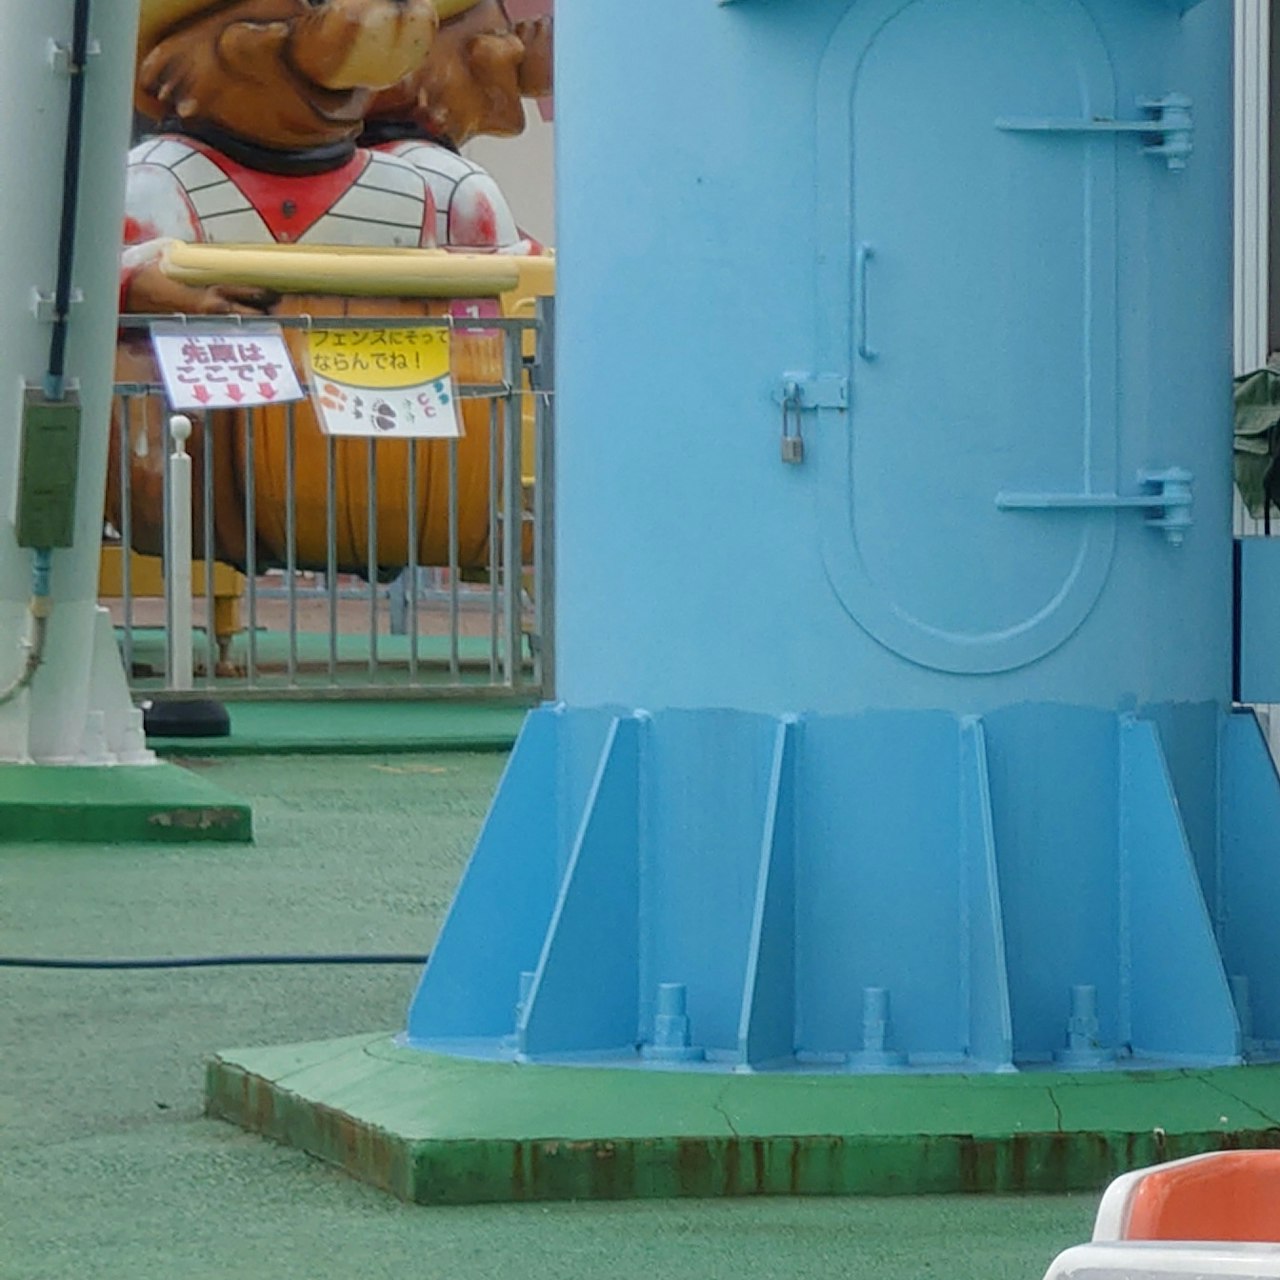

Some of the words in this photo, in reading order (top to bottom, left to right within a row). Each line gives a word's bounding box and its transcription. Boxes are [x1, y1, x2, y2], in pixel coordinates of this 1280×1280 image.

[313, 328, 450, 348] フェンスにそって
[176, 362, 283, 384] ここです
